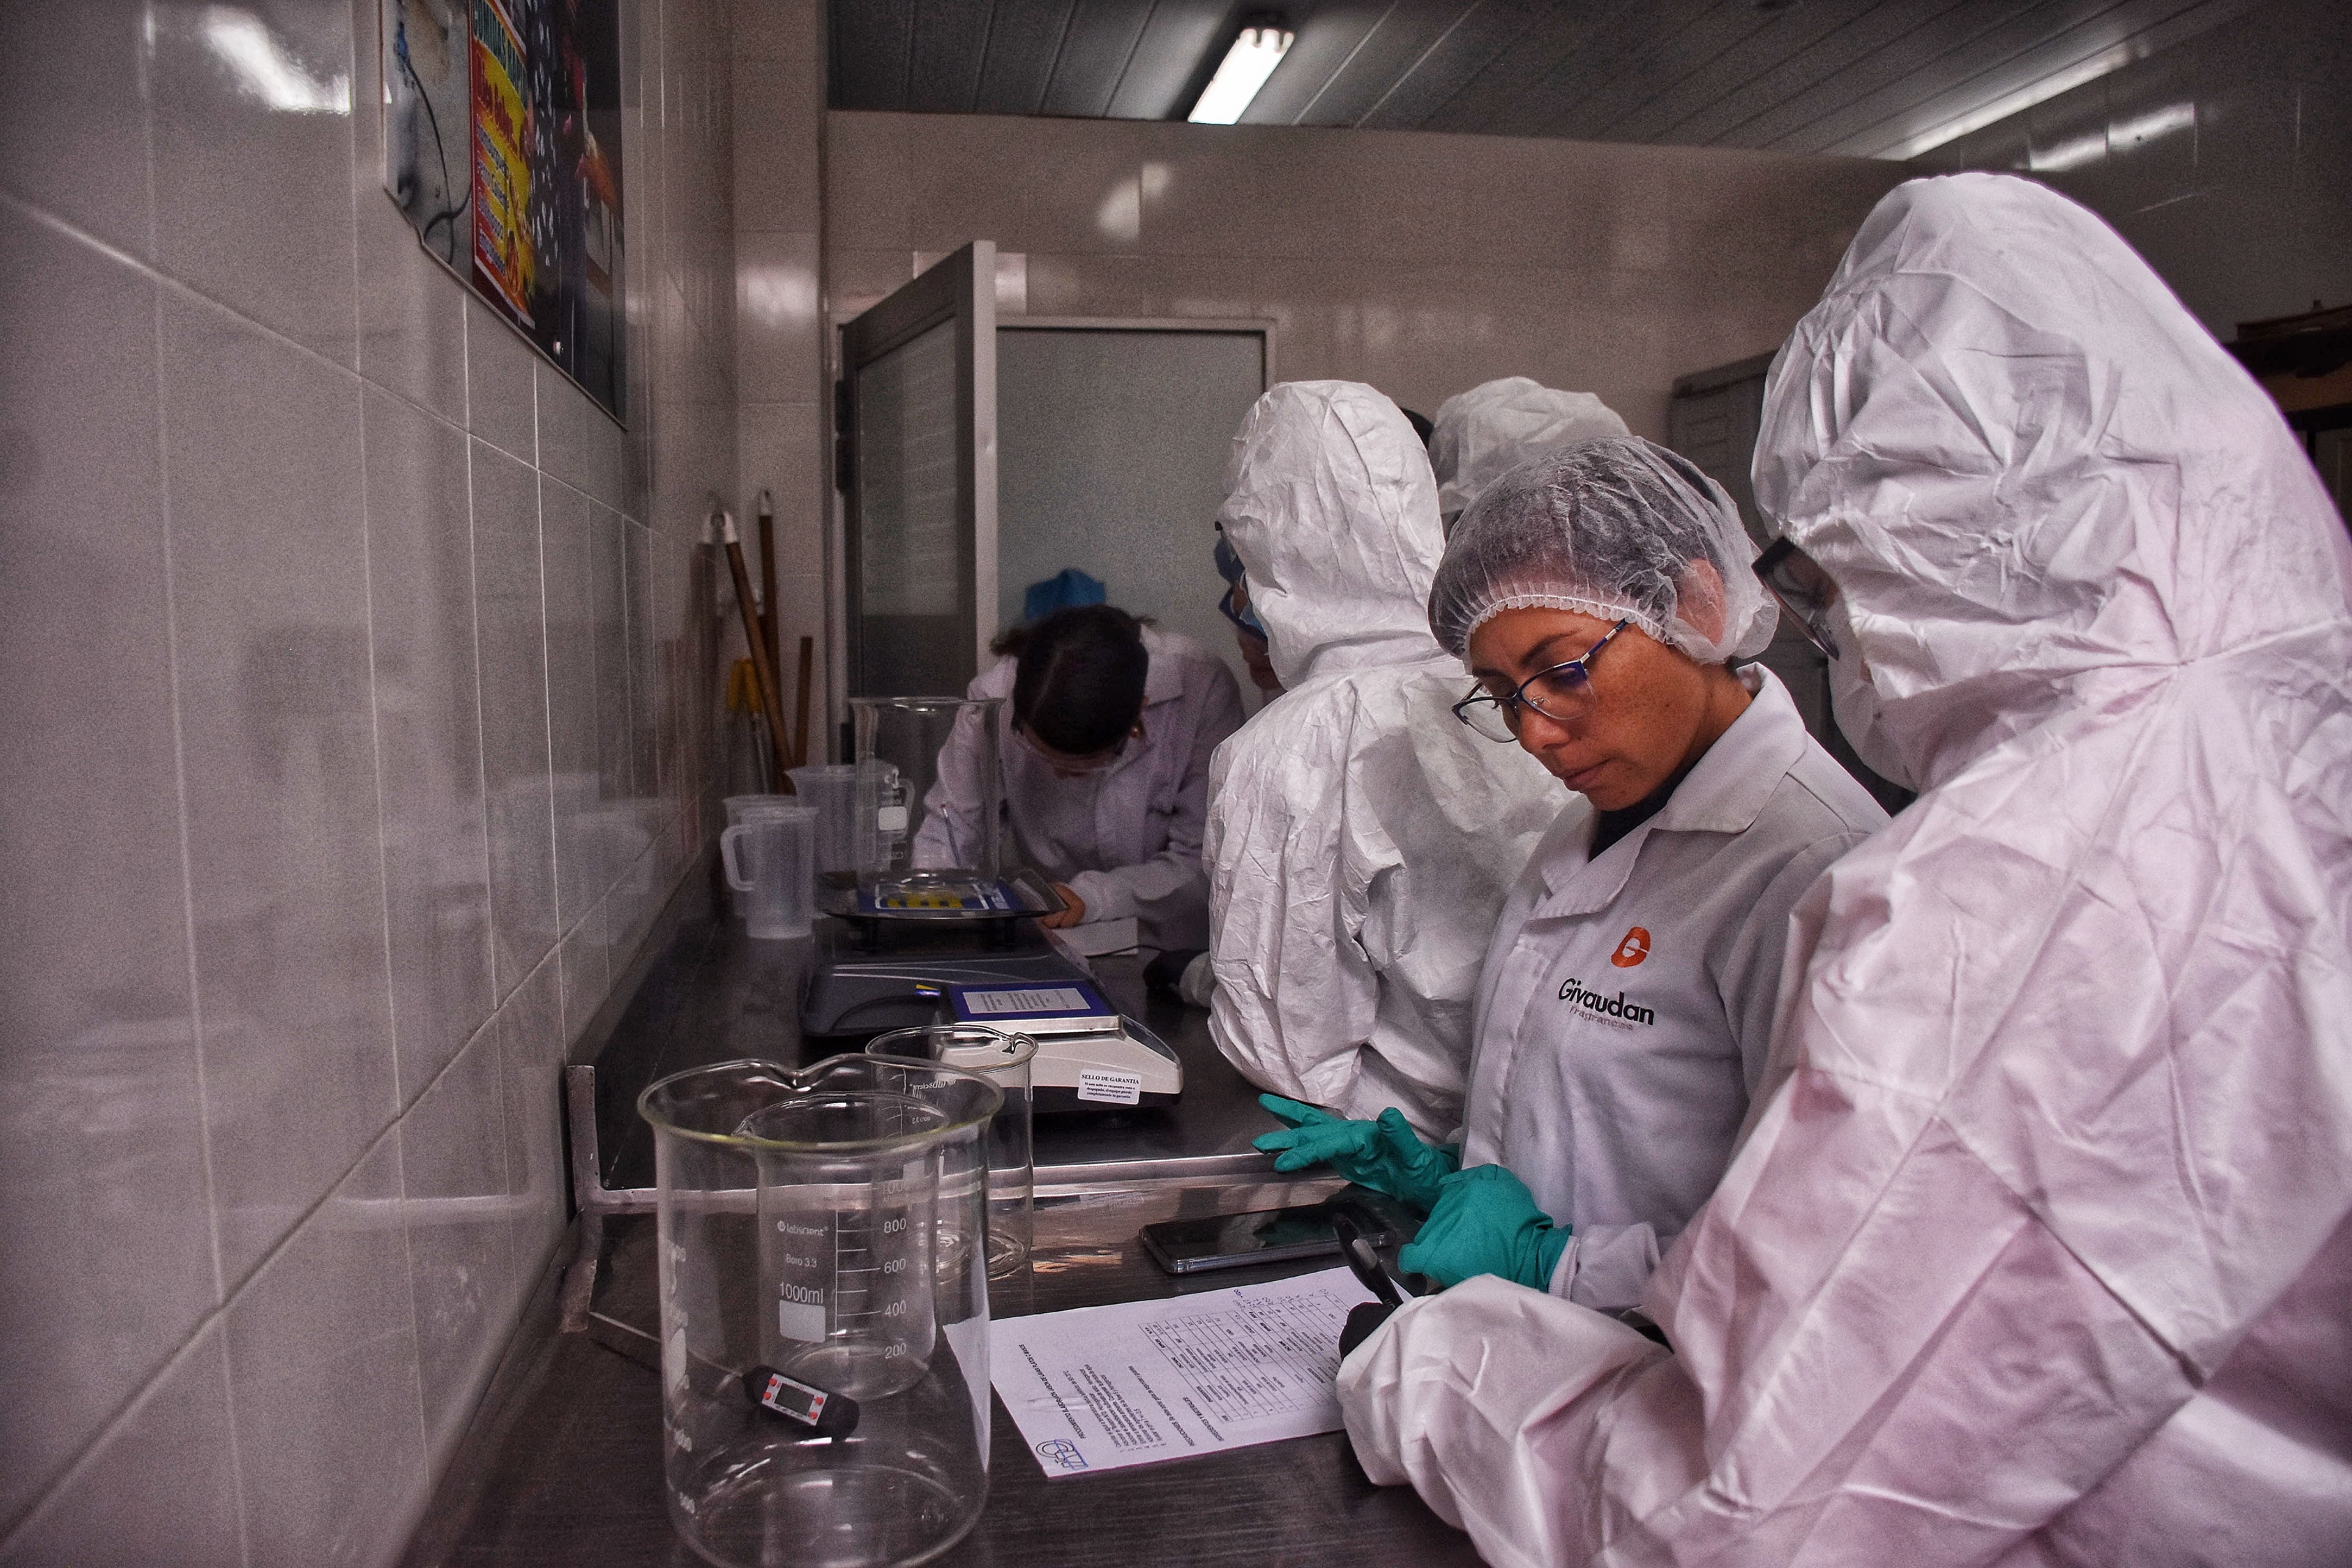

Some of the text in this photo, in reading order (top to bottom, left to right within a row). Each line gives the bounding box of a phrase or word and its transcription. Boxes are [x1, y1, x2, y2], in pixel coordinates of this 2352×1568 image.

[1559, 978, 1654, 1025] Givaudan
[1570, 1005, 1633, 1031] Fragrances
[884, 1218, 906, 1233] 800
[786, 1254, 818, 1268] Boro 3.3
[884, 1258, 906, 1274] 600
[779, 1282, 824, 1303] 1000ml
[884, 1300, 907, 1318] 400
[884, 1343, 907, 1359] 200
